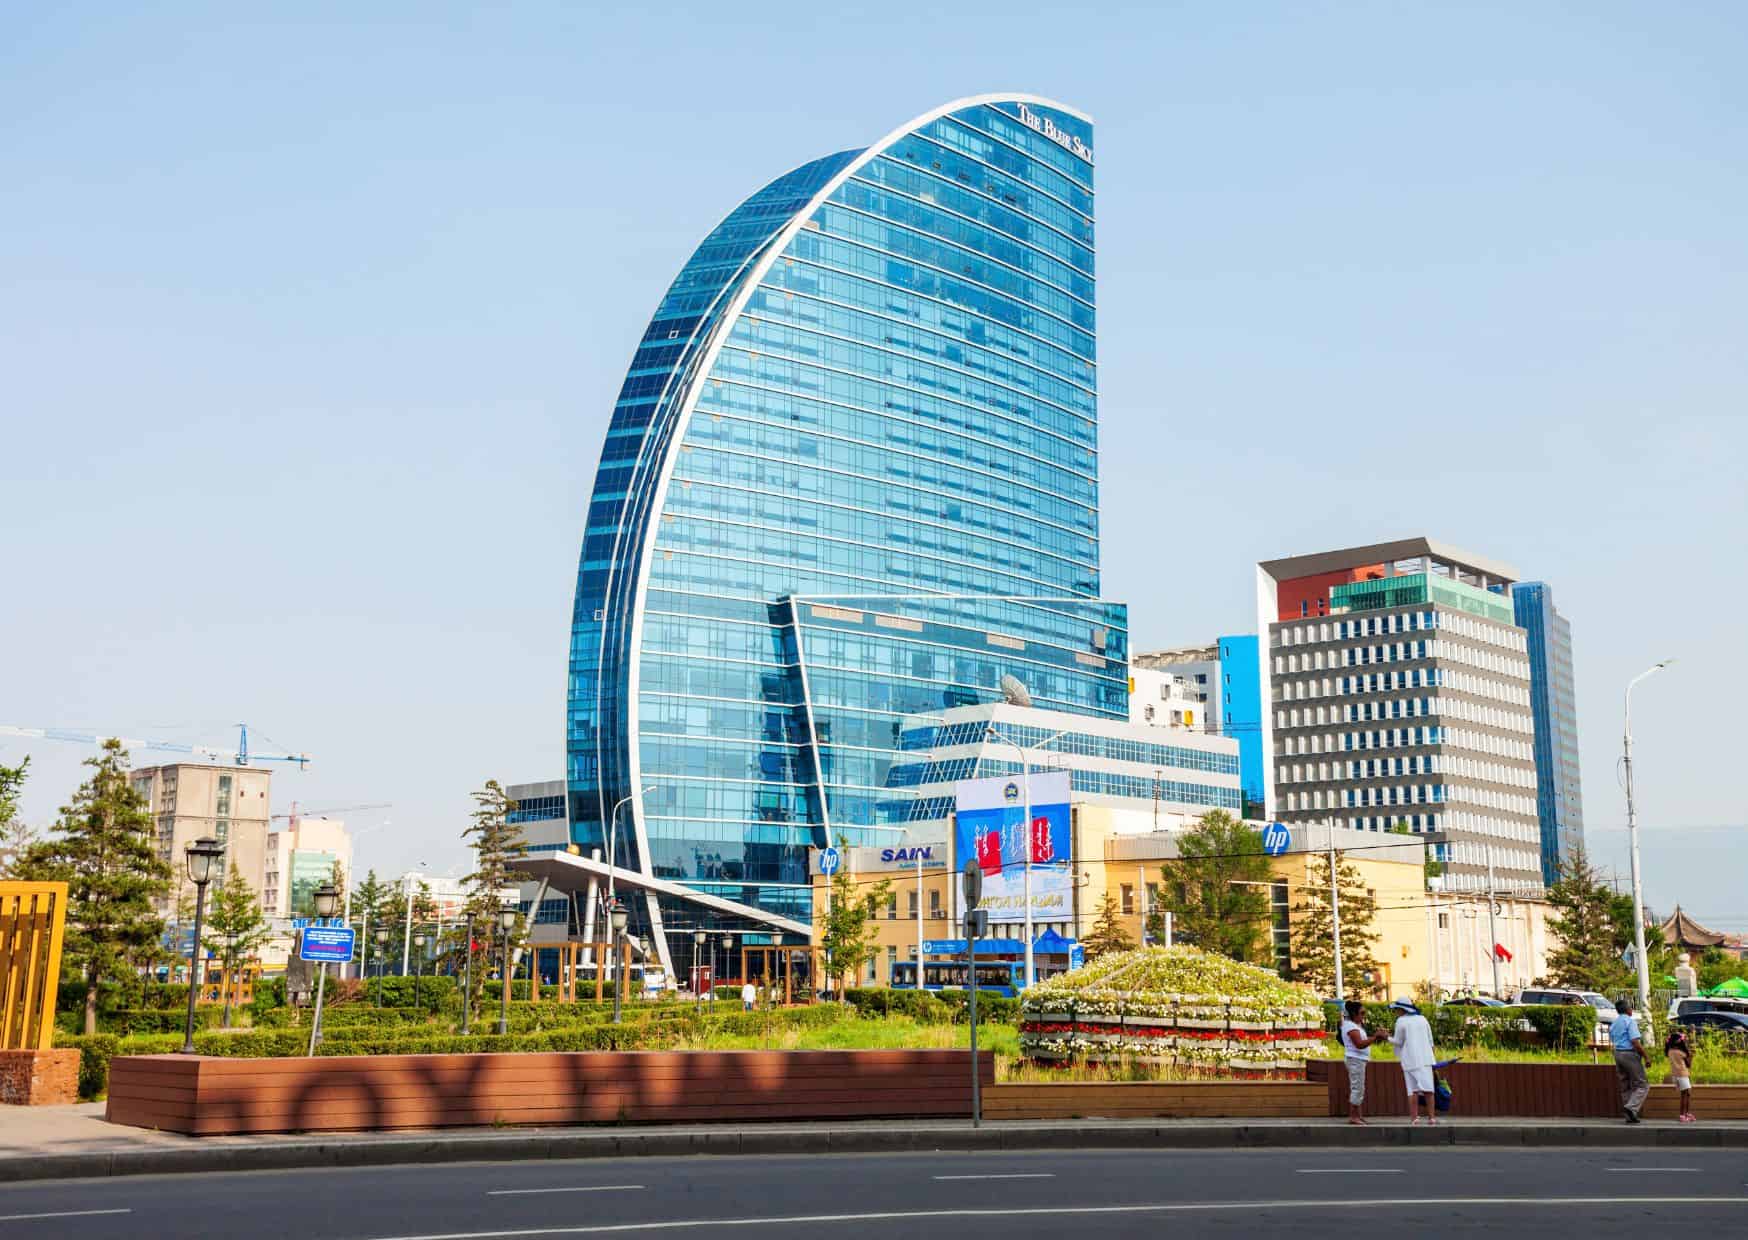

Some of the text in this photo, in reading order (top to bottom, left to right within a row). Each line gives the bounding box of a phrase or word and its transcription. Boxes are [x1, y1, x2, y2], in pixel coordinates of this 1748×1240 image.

[1264, 823, 1288, 856] hp
[821, 848, 838, 875] hp
[880, 846, 932, 862] SAIN
